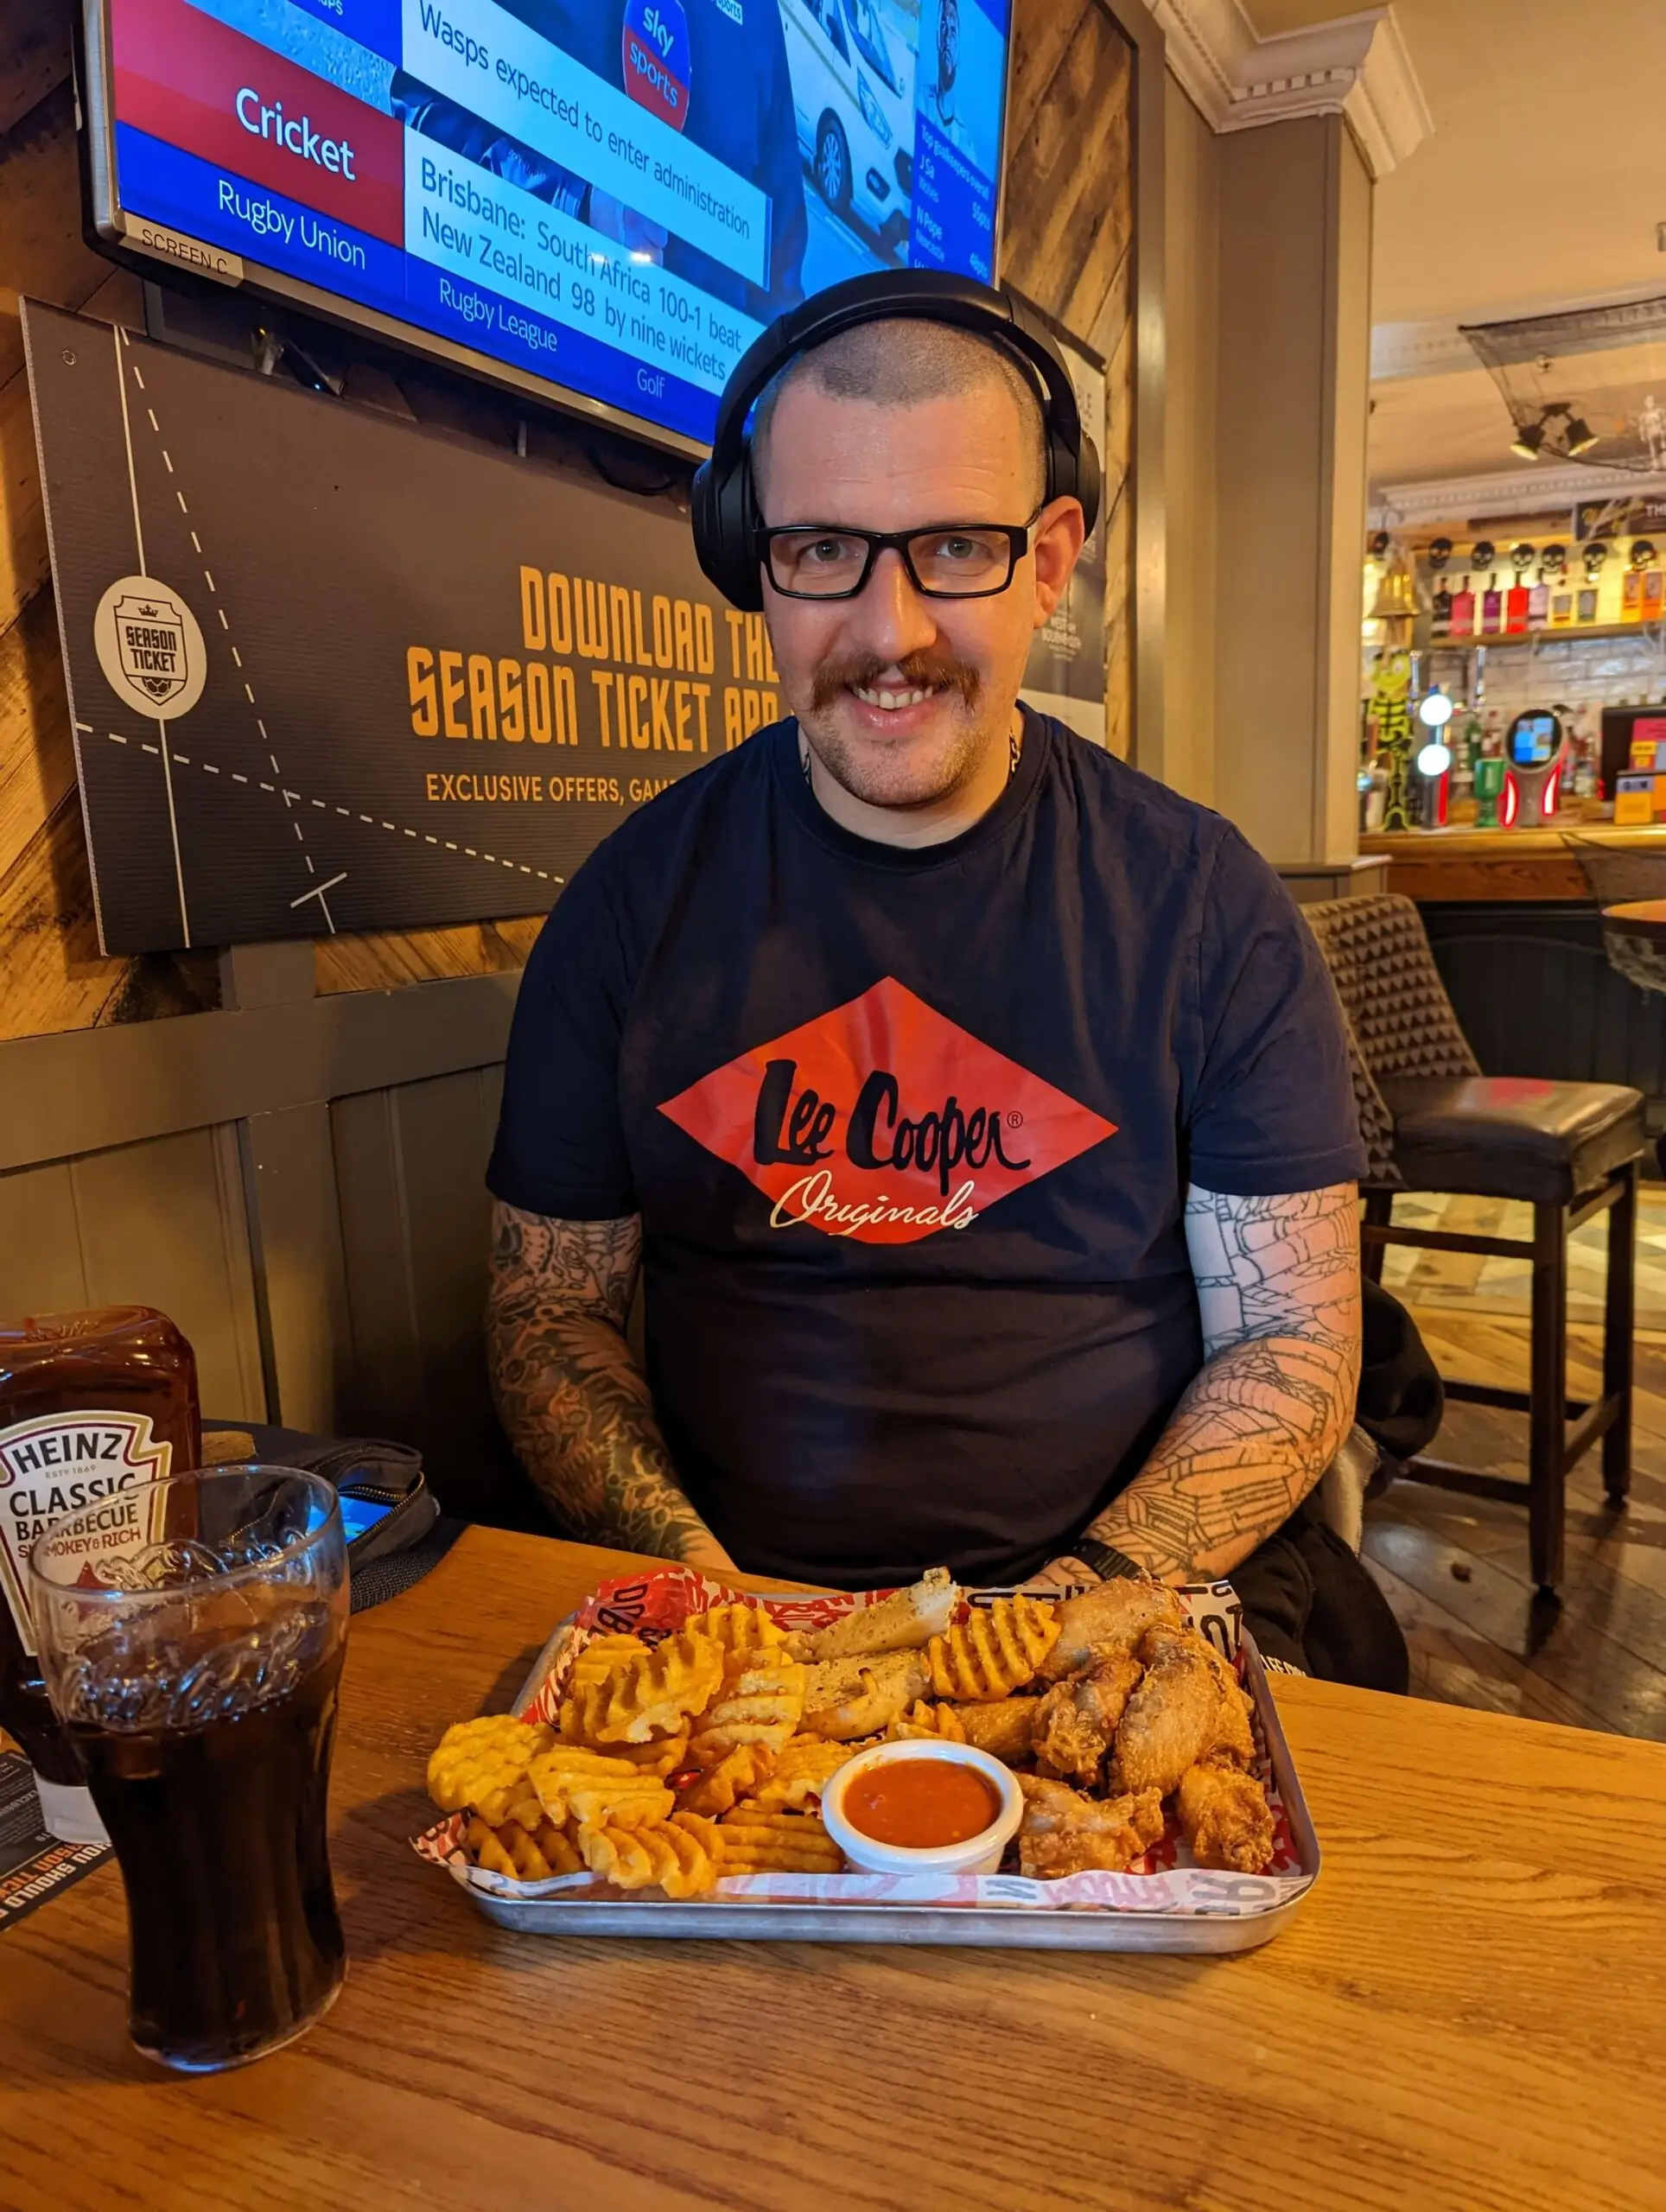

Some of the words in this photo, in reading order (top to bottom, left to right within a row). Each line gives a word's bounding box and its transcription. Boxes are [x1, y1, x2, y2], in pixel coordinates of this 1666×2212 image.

[643, 7, 674, 58] sky
[630, 41, 677, 108] sports
[235, 87, 356, 181] Cricket
[419, 0, 489, 70] Wasps
[496, 58, 579, 128] expected
[585, 111, 603, 143] to
[608, 131, 650, 173] enter
[654, 159, 750, 240] administration
[142, 228, 212, 269] SCREEN
[216, 257, 228, 275] C
[219, 180, 293, 244] Rugby
[300, 219, 366, 270] Union
[422, 156, 525, 240] Brisbane:
[537, 220, 595, 276] South
[601, 255, 650, 305] Africa
[658, 286, 701, 331] 100-1
[709, 312, 741, 353] beat
[423, 206, 473, 257] New
[479, 234, 561, 302] Zealand
[572, 282, 595, 317] 98
[605, 297, 626, 338] by
[632, 317, 665, 352] nine
[670, 335, 726, 382] wickets
[440, 277, 494, 329] Rugby
[499, 304, 557, 353] League
[637, 367, 664, 399] Golf
[125, 626, 177, 652] SEASON
[520, 565, 715, 675] DOWNLOAD
[130, 649, 176, 672] TICKET
[407, 646, 578, 746] SEASON
[592, 670, 710, 753] TICKET
[426, 773, 543, 802] EXCLUSIVE
[549, 778, 625, 806] OFFERS,
[753, 1058, 836, 1166] Lee
[846, 1070, 1031, 1196] Cooper
[769, 1170, 978, 1236] Originals
[11, 1433, 123, 1474] HEINZ
[10, 1472, 139, 1517] CLASSIC
[103, 1527, 141, 1550] RICH
[5, 1862, 76, 1908] SHOULD
